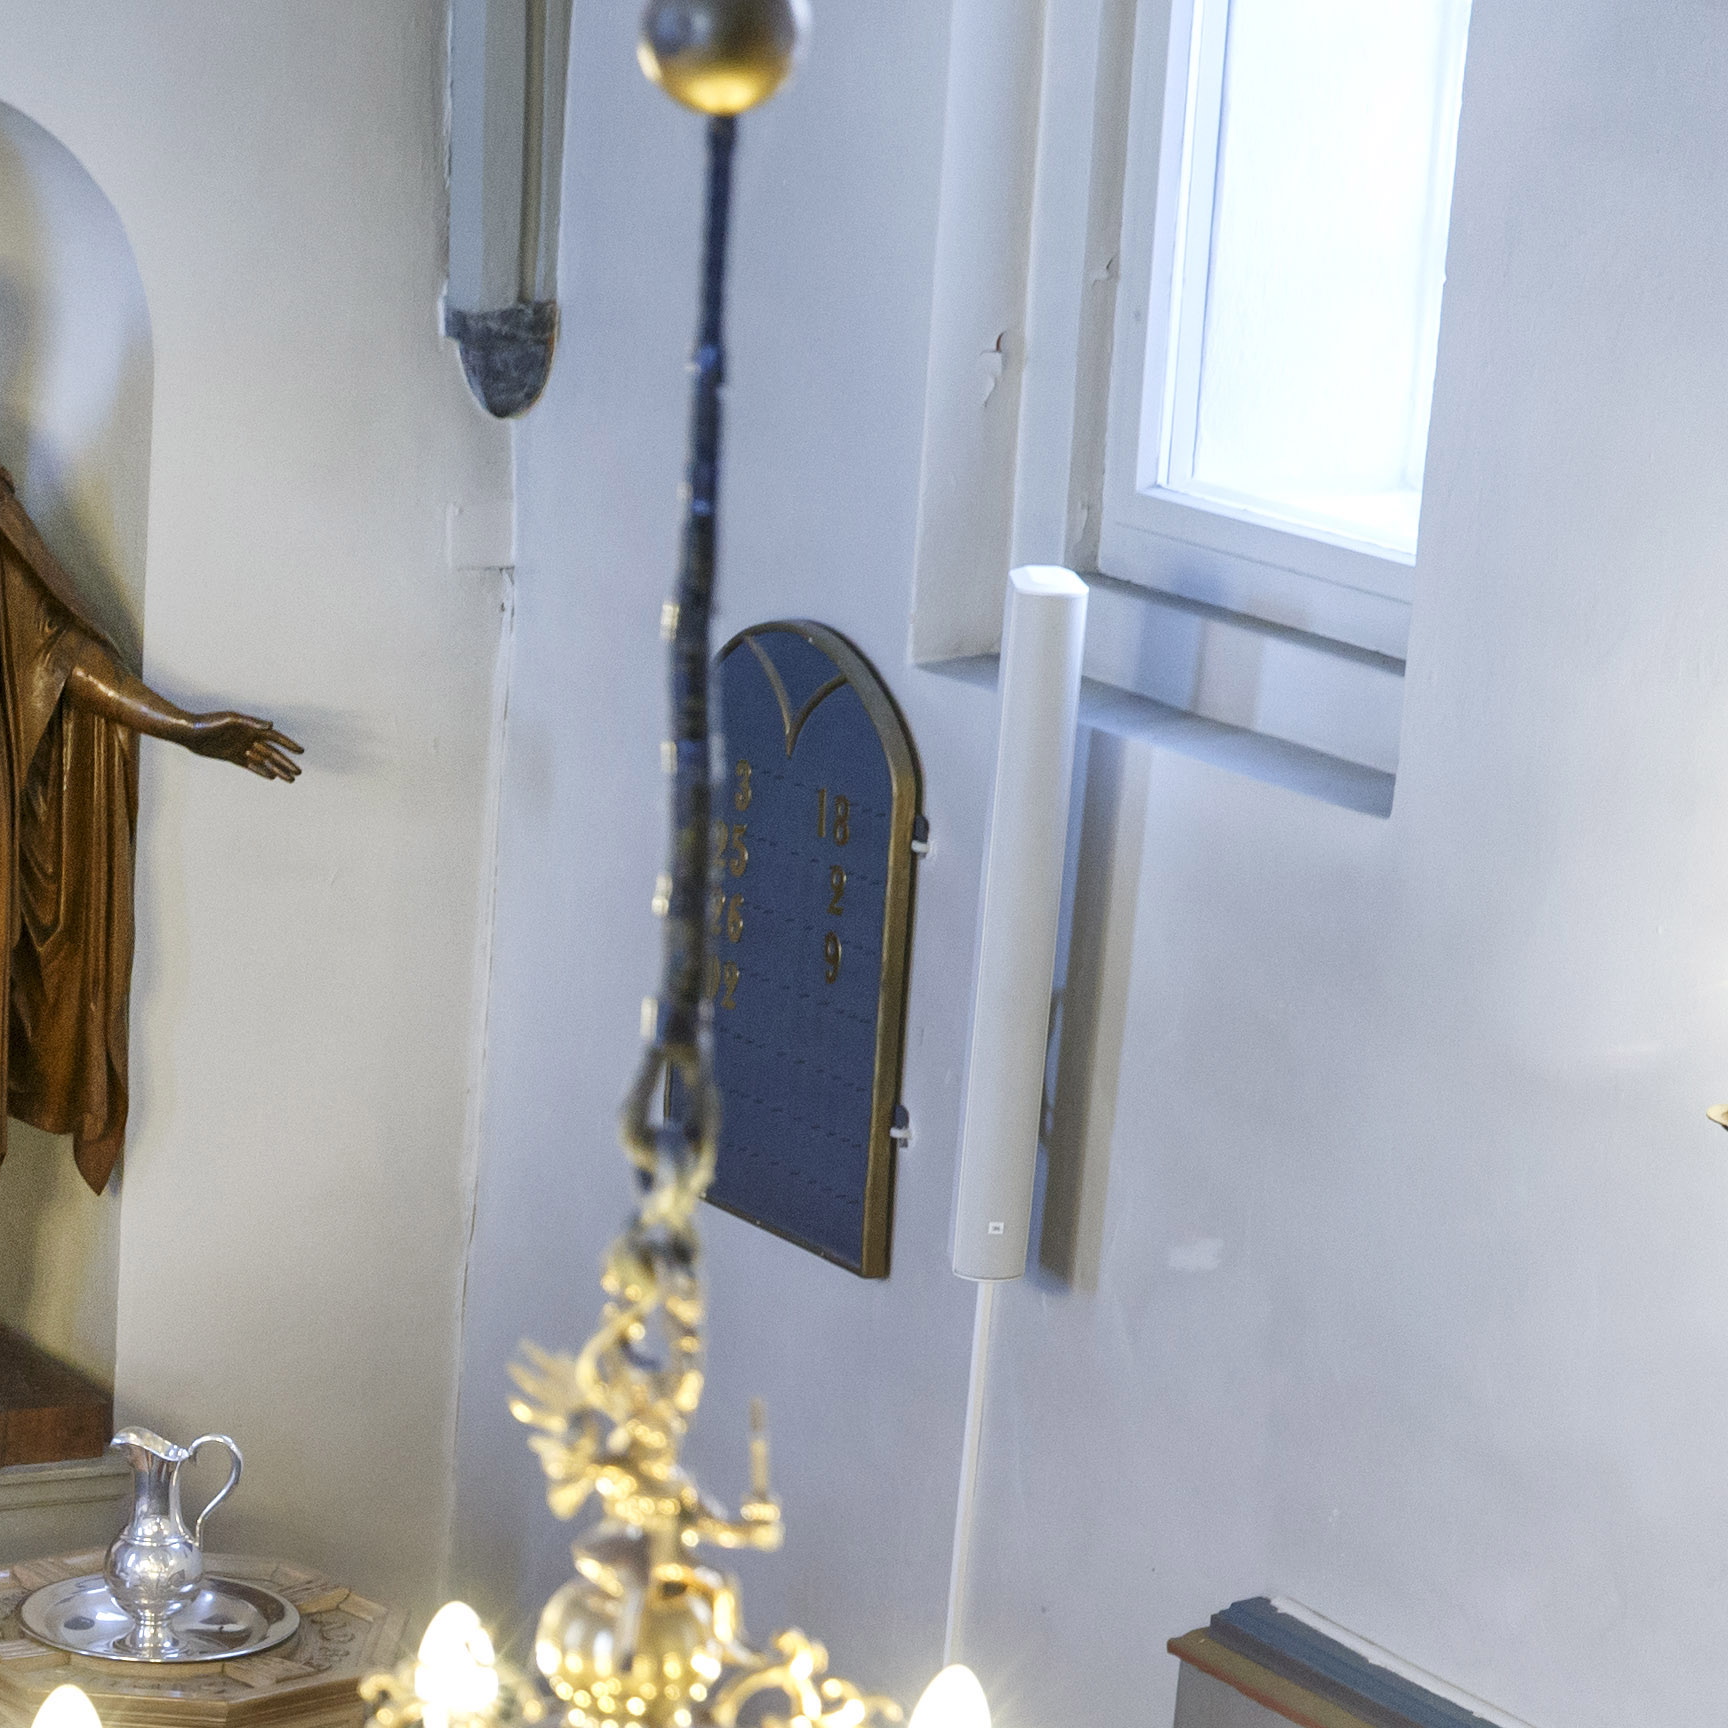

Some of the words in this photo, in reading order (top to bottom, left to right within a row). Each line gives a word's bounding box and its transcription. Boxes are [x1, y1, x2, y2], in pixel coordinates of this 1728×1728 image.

[735, 759, 752, 811] 3
[818, 788, 850, 846] 18
[827, 865, 847, 916] 2
[824, 931, 842, 984] 9
